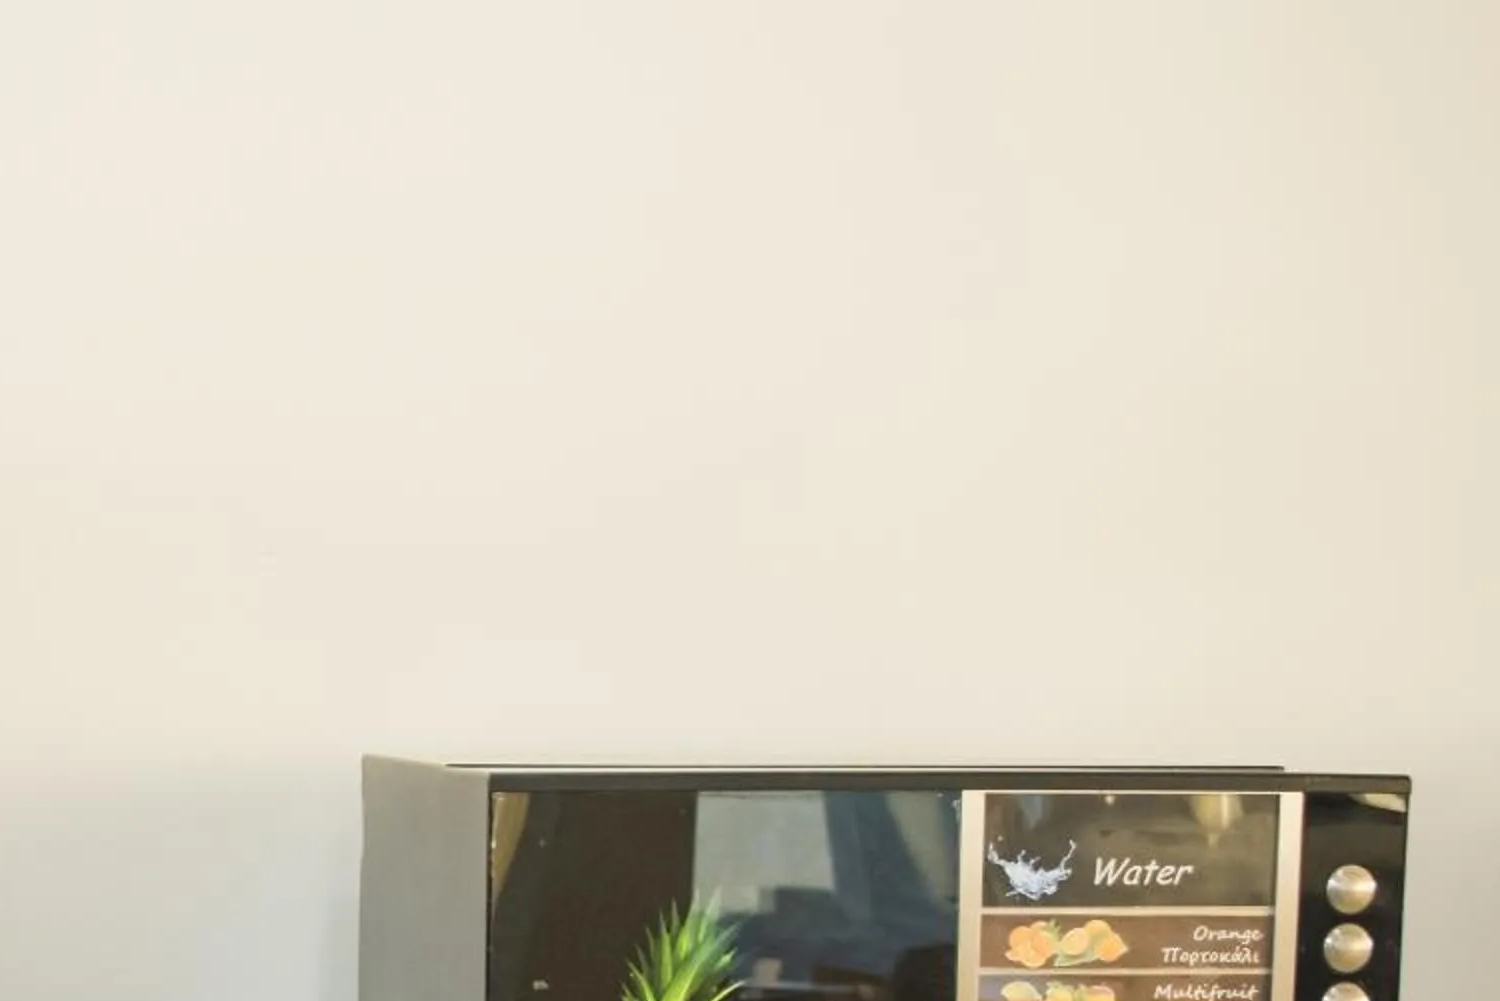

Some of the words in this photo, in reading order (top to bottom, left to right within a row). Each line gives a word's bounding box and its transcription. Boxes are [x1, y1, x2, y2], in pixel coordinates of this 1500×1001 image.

[1093, 857, 1195, 888] Water
[1193, 925, 1264, 945] Orange
[1161, 945, 1260, 966] Πορτοκάλι
